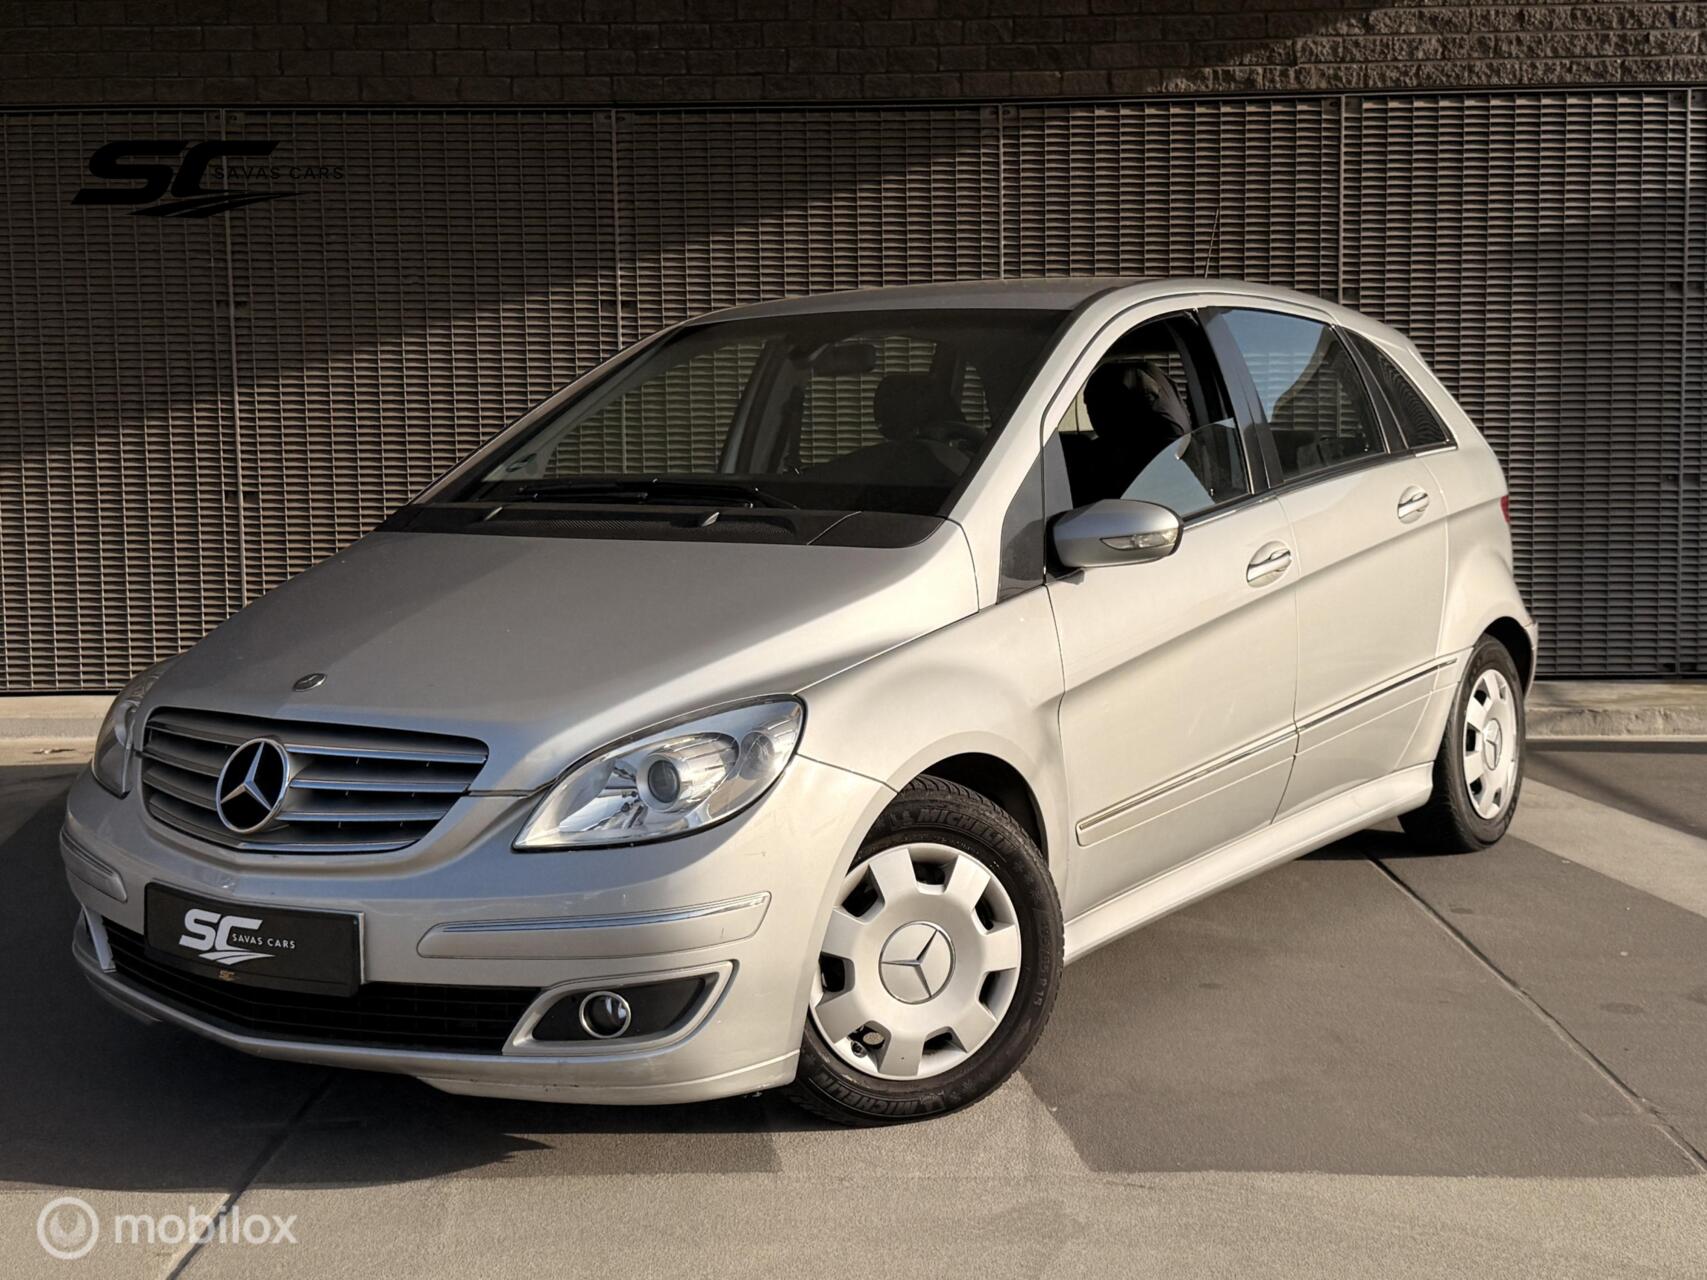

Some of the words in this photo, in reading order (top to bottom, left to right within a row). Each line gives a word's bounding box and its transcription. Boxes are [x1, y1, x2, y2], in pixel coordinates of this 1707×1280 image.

[917, 807, 1019, 852] MICHELIN
[178, 908, 263, 952] SC
[232, 933, 263, 946] SAVAS
[267, 938, 296, 950] CARS
